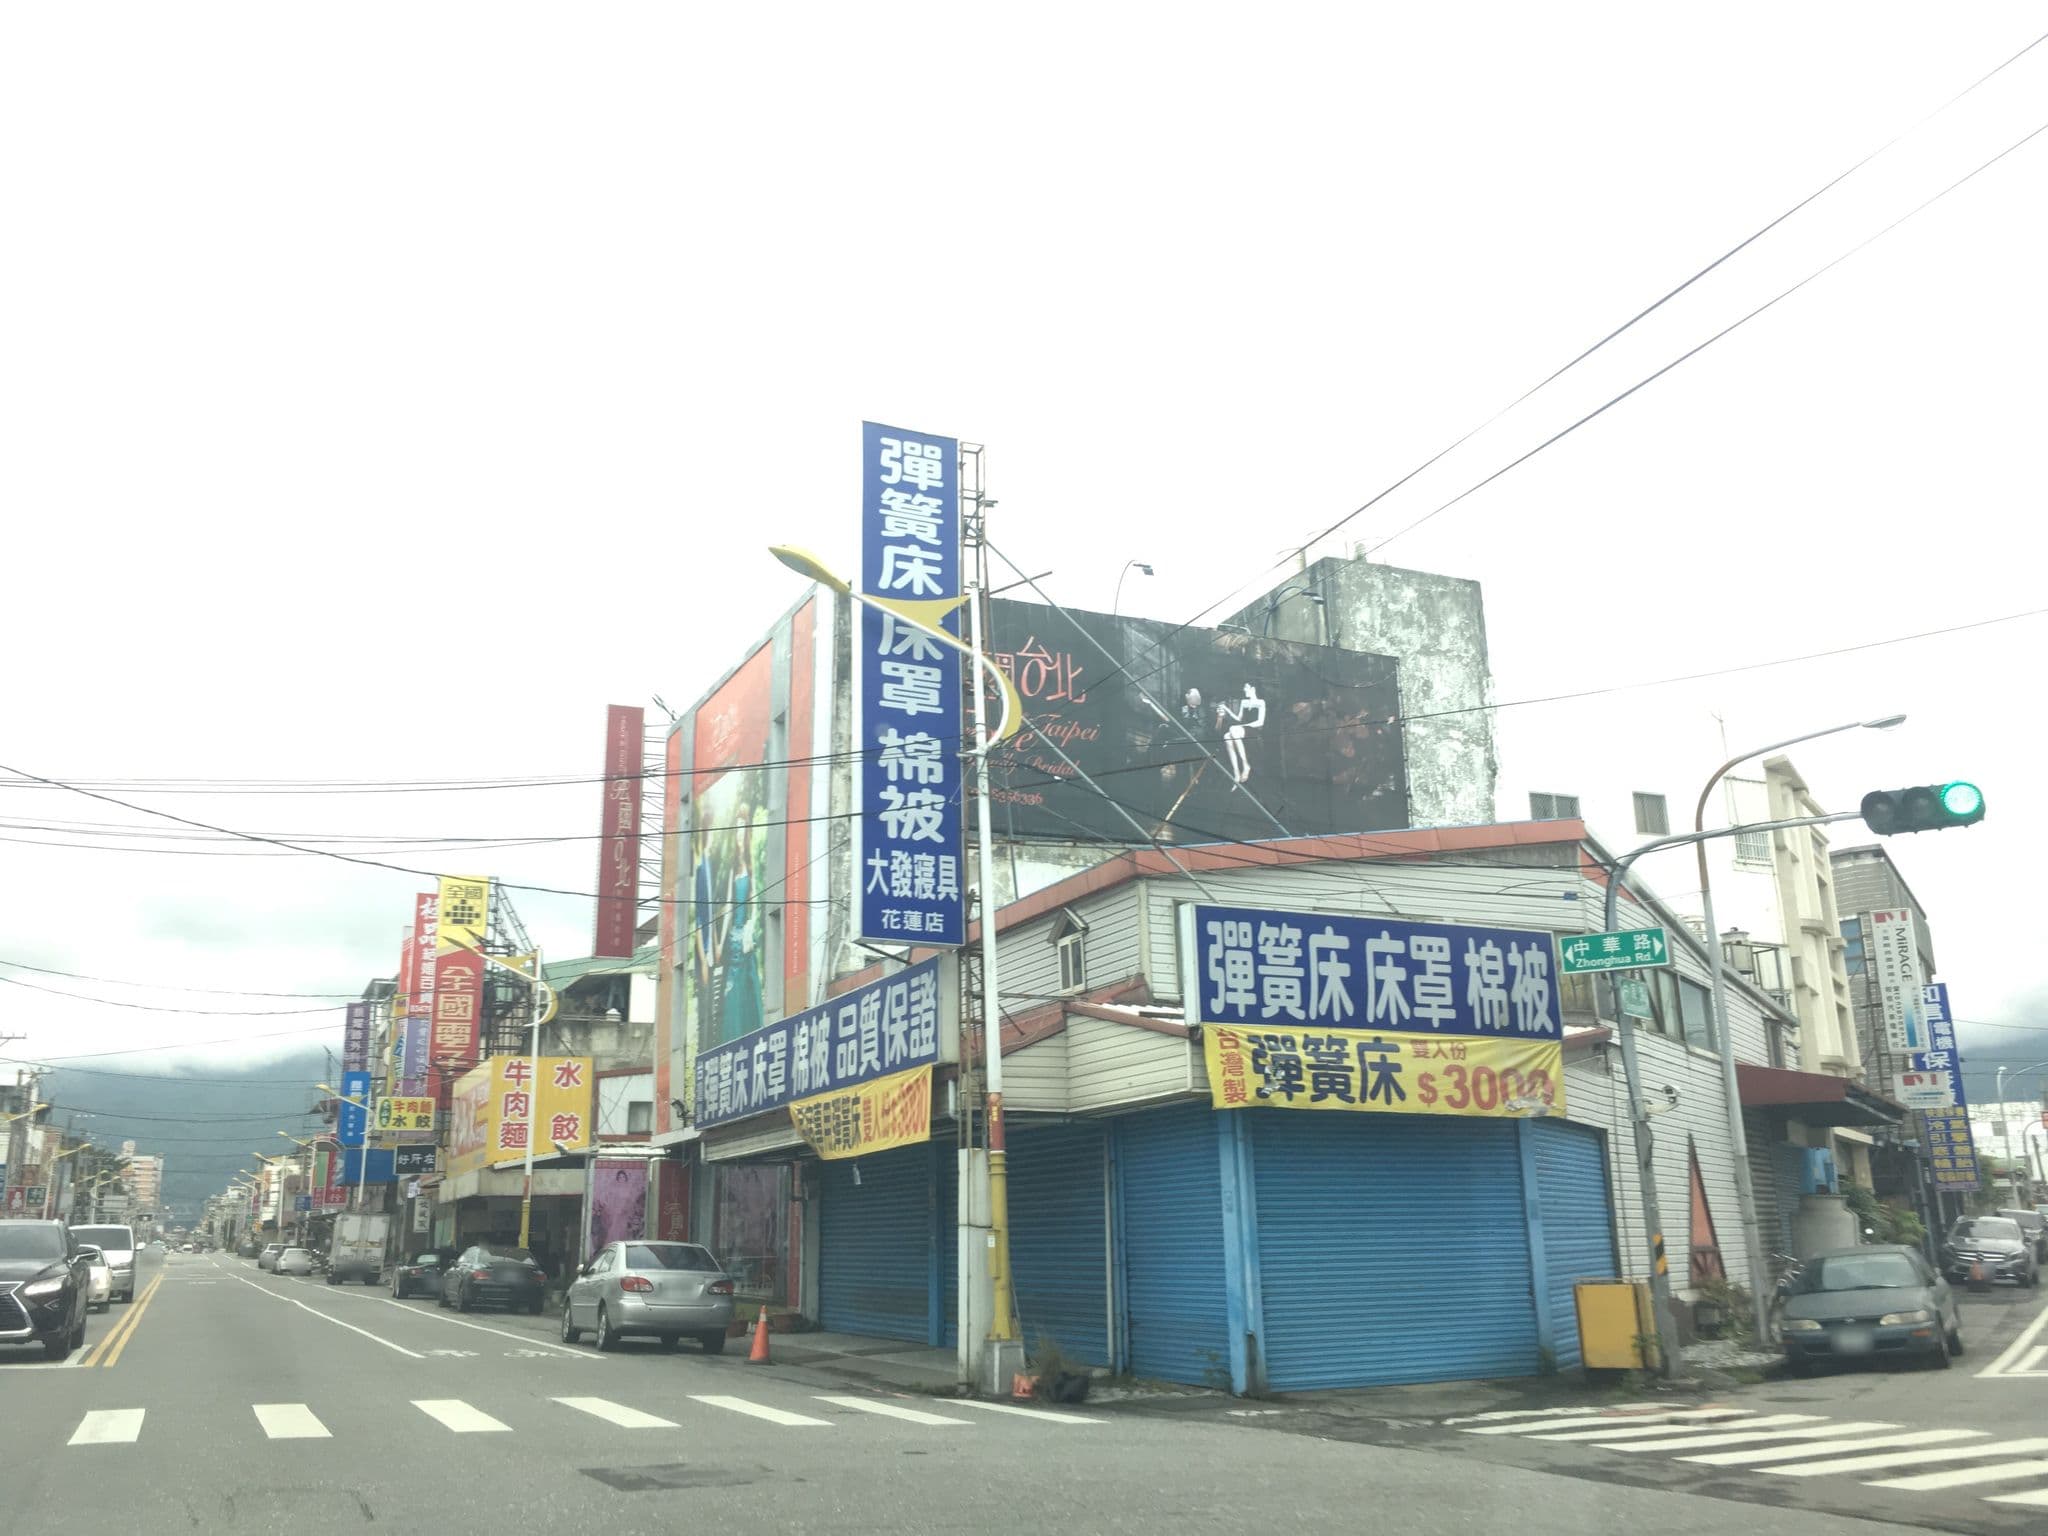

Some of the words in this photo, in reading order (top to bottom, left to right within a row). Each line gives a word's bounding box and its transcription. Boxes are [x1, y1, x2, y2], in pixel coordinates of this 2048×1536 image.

[878, 437, 944, 596] 彈簧床
[878, 727, 944, 843] 棉被
[867, 849, 959, 903] 大發寢具
[881, 909, 945, 934] 花蓮店
[1574, 934, 1651, 956] 中華路
[1207, 920, 1355, 1023] 彈簧床
[1366, 931, 1458, 1027] 床罩
[1464, 937, 1554, 1034] 棉被
[1576, 955, 1631, 968] Zhonghua
[1635, 952, 1655, 962] Rd.
[751, 1029, 787, 1108] 床罩
[791, 1010, 831, 1096] 棉被
[836, 969, 937, 1080] 品質保證
[1216, 1028, 1248, 1104] 台灣製
[1247, 1033, 1407, 1106] 彈簧床
[1410, 1039, 1467, 1061] 雙人份
[392, 1115, 430, 1129] 水餃
[393, 1100, 432, 1115] 牛肉麵
[500, 1060, 532, 1149] 牛肉麵
[551, 1061, 581, 1141] 水餃
